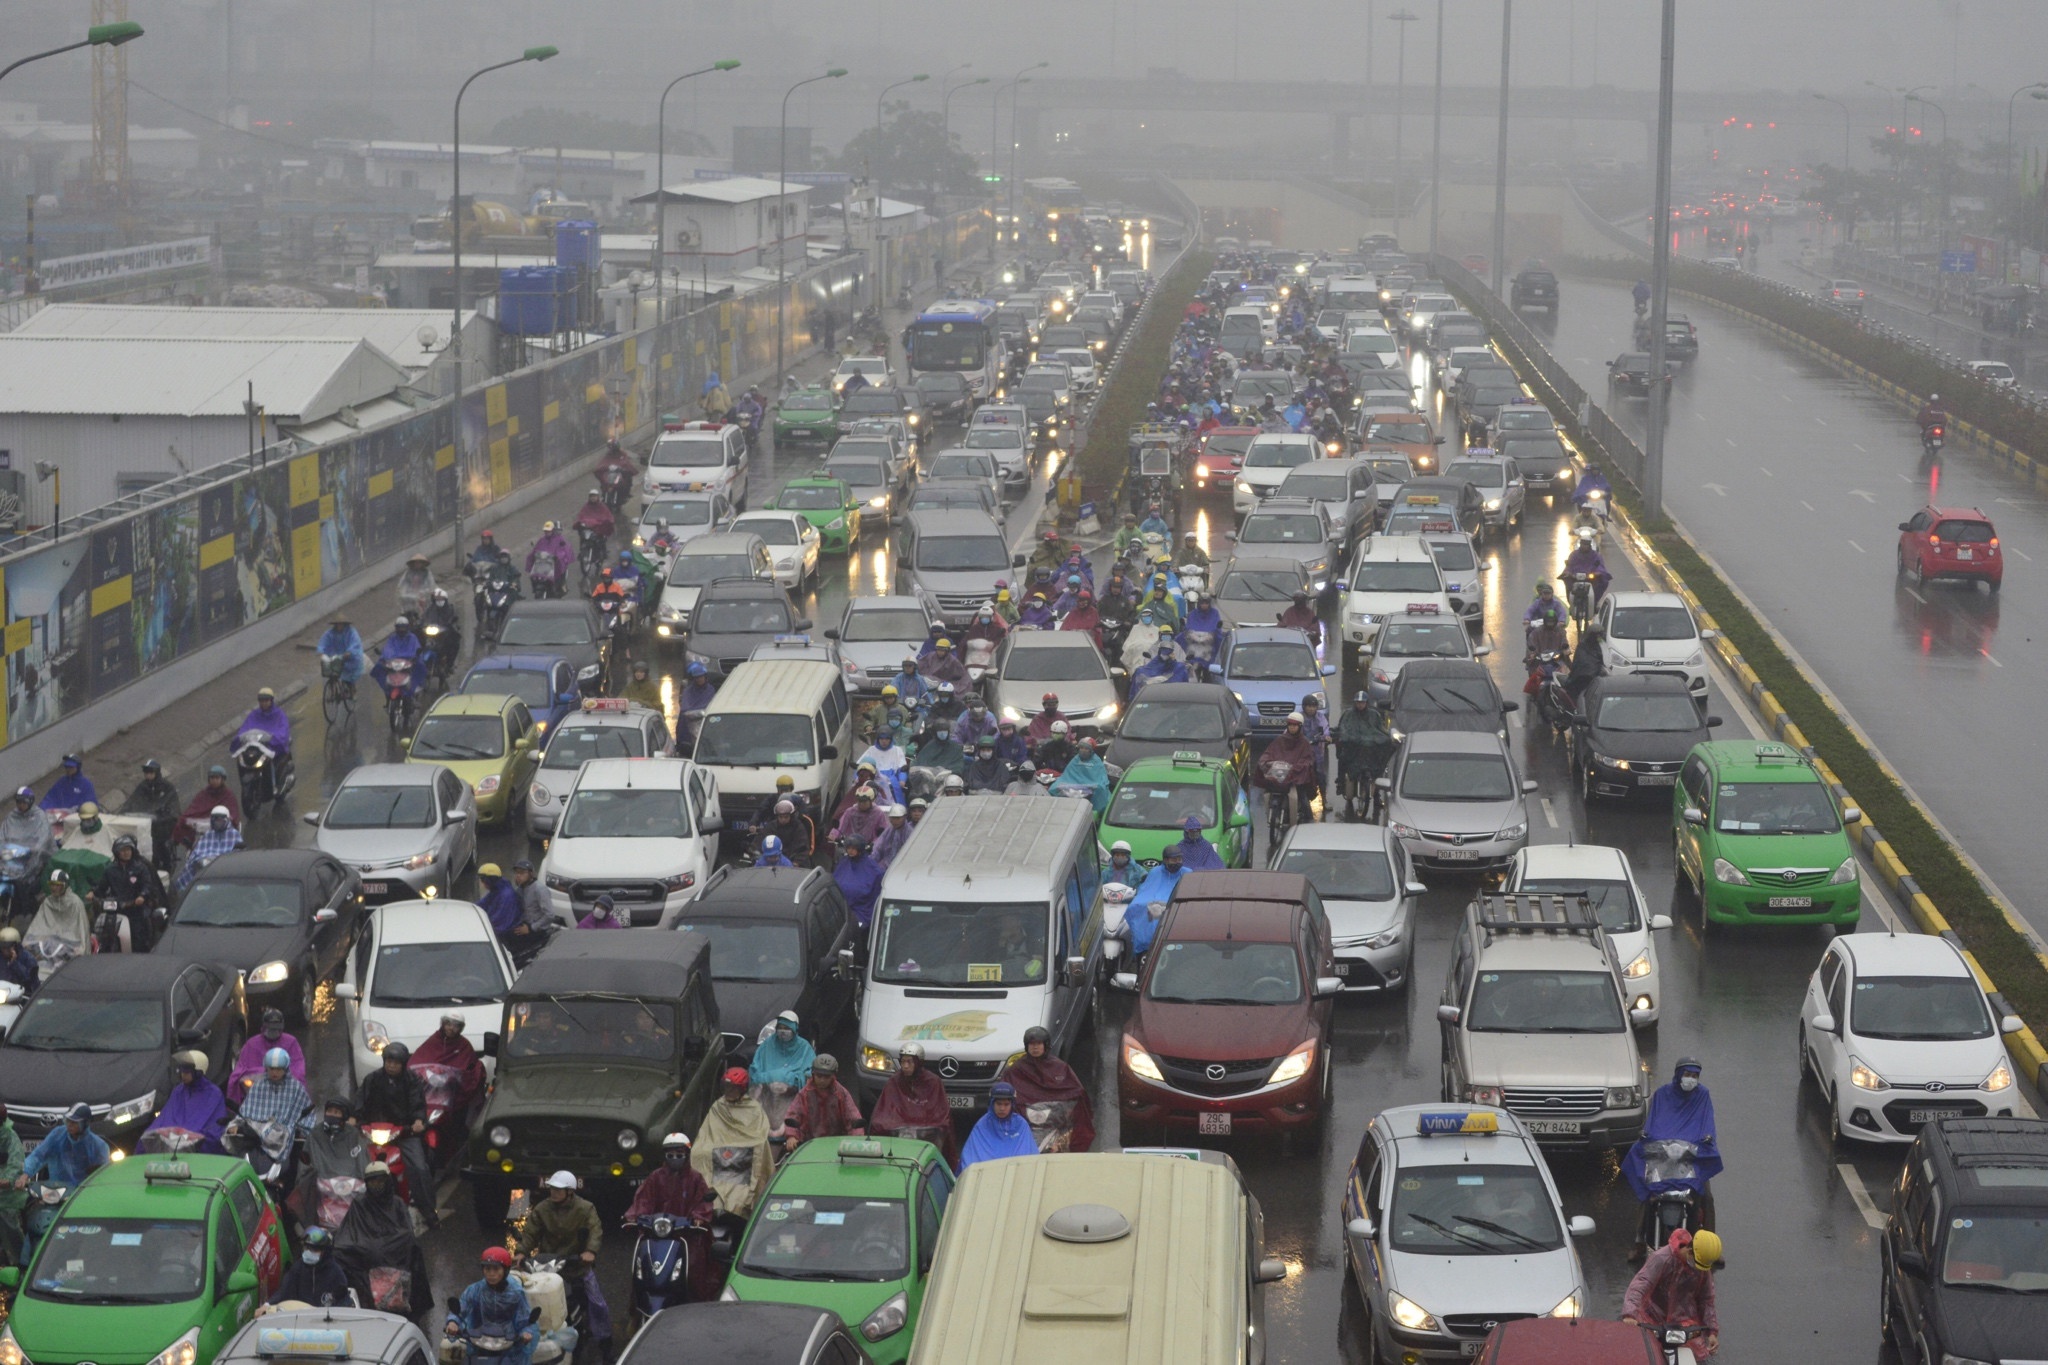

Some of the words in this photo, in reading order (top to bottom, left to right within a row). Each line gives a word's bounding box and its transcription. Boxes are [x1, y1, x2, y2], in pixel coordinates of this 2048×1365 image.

[1177, 751, 1197, 759] TAXI
[985, 969, 998, 980] 11
[1207, 1113, 1224, 1124] 29C
[1463, 1118, 1490, 1129] TAXI
[842, 1140, 880, 1153] TAXI
[150, 1162, 188, 1174] TAXI
